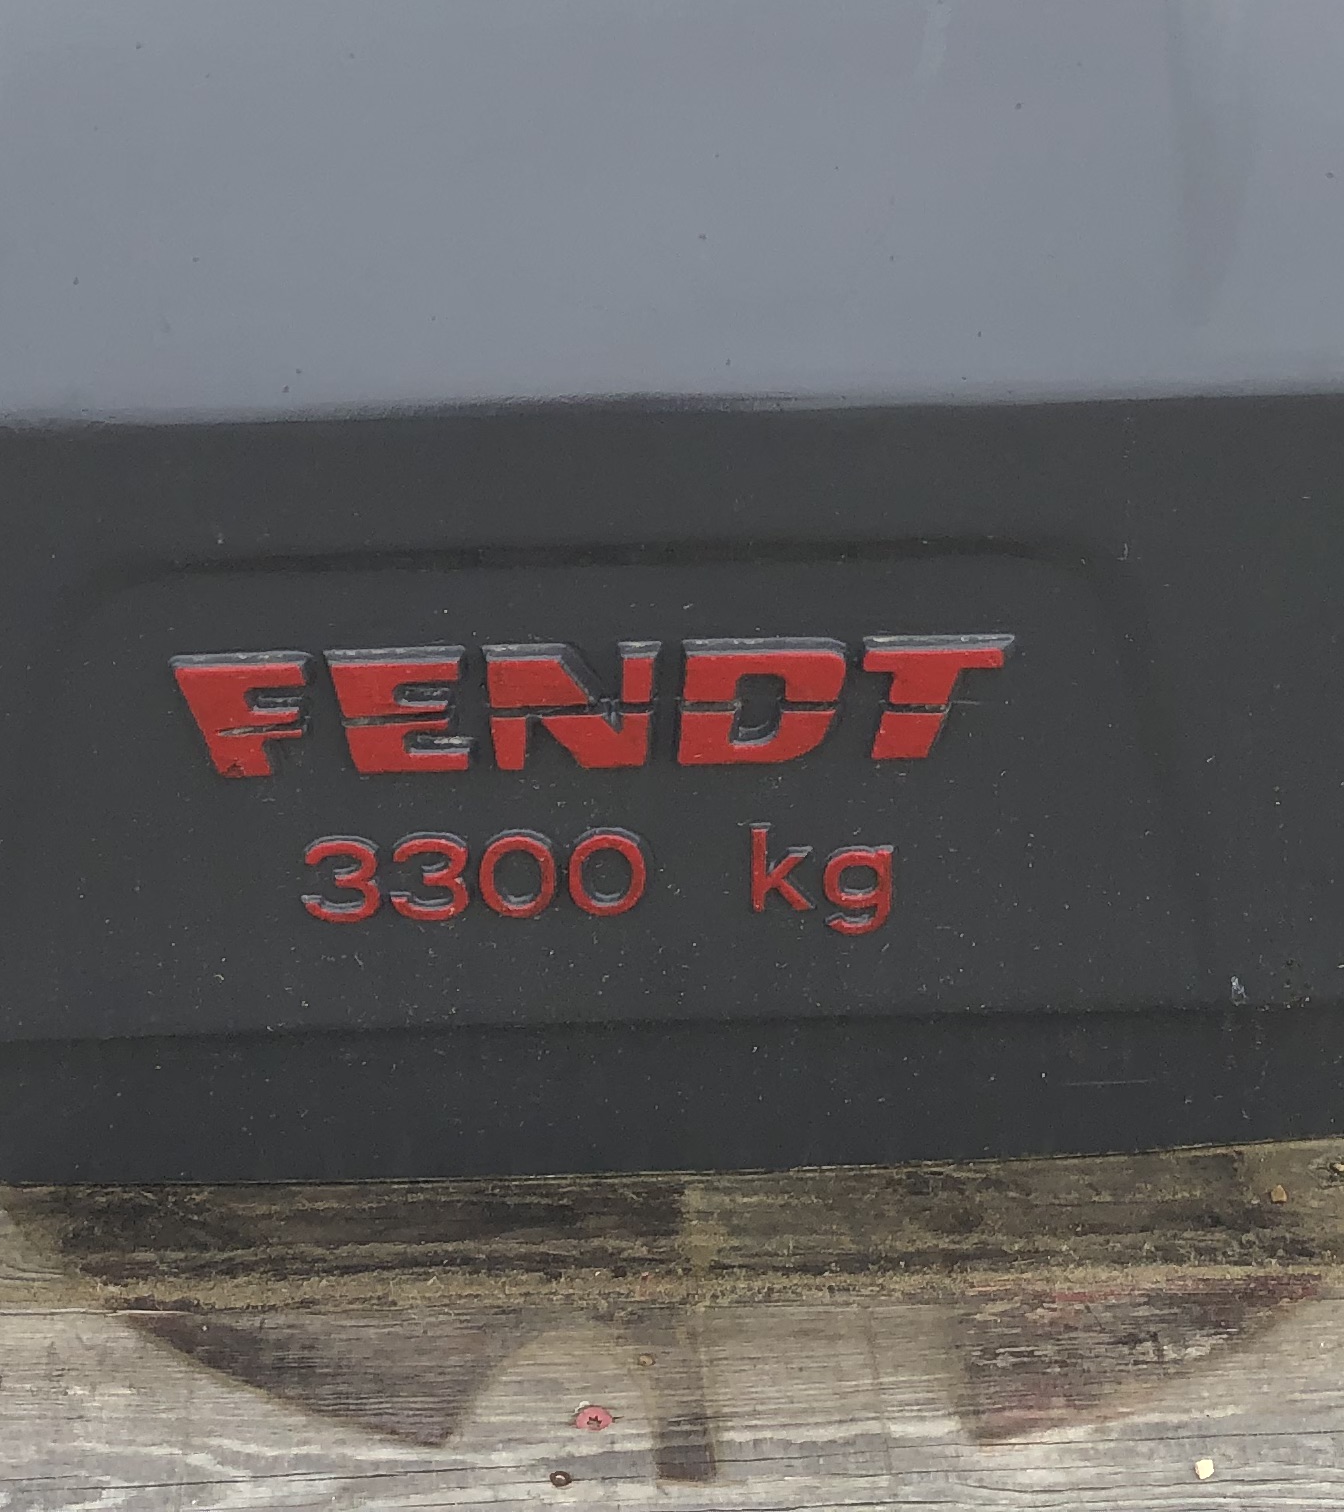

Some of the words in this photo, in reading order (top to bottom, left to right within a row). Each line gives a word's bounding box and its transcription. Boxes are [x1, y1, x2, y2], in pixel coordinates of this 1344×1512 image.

[168, 634, 1015, 778] FENDT
[300, 826, 647, 923] 3300
[748, 822, 896, 934] kg
